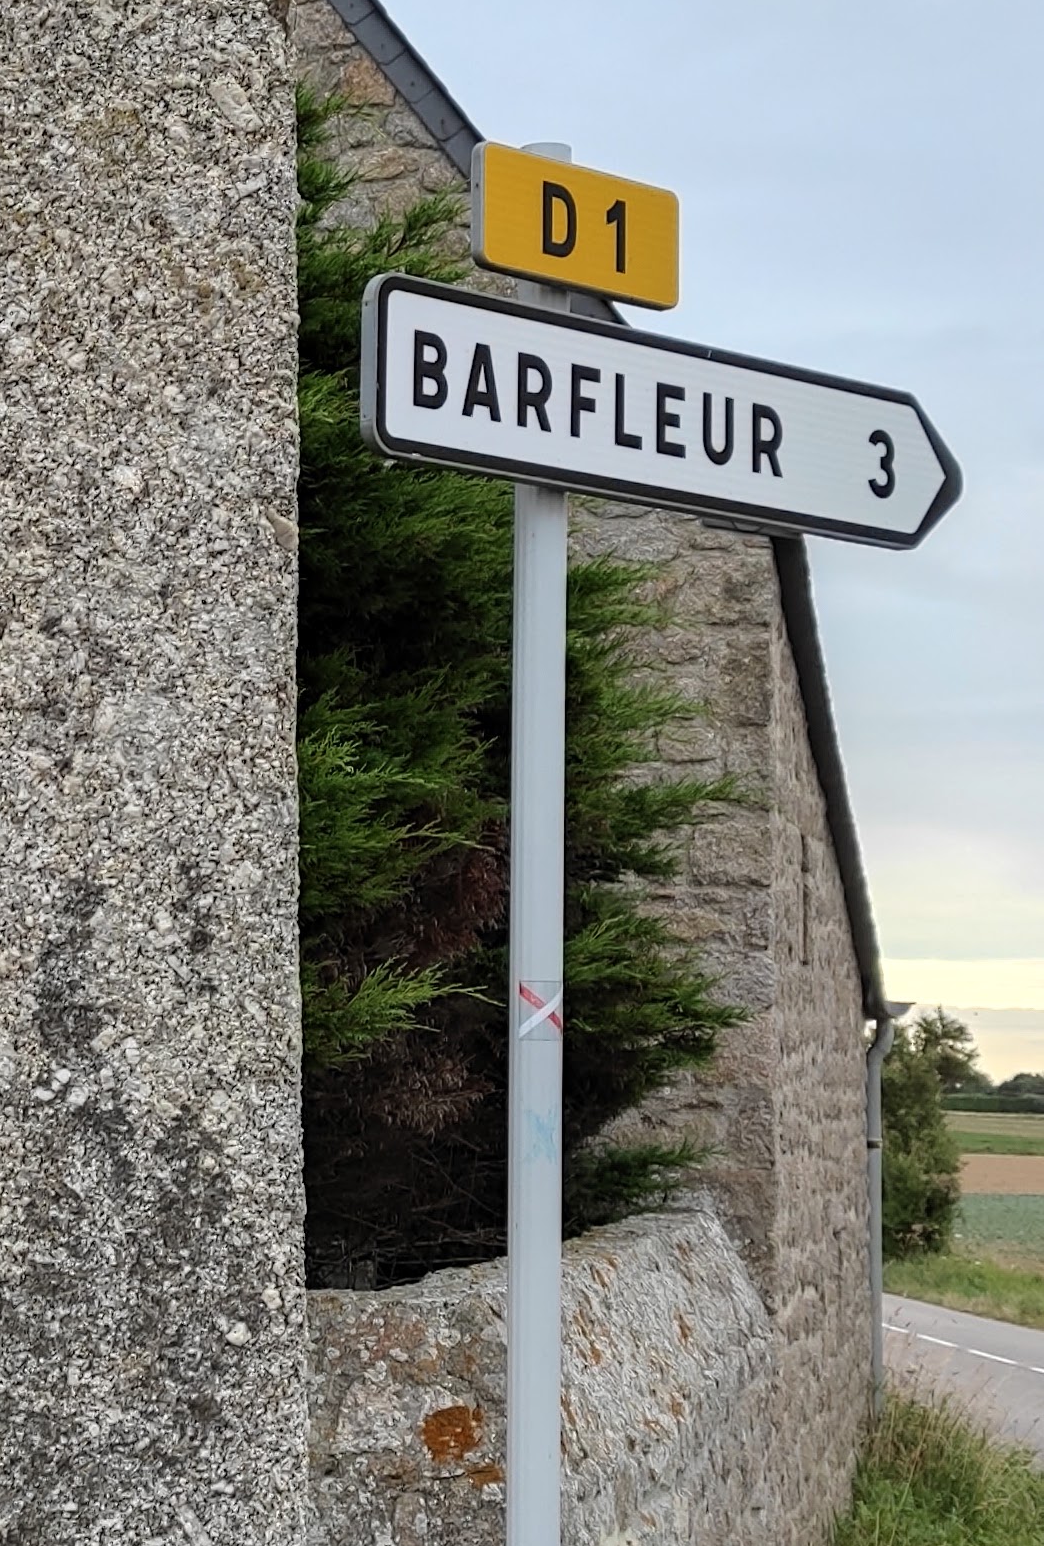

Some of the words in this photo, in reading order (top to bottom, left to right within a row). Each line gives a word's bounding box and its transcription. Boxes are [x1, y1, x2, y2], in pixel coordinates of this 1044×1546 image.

[542, 180, 577, 258] D
[605, 199, 626, 274] 1
[412, 329, 783, 478] BARFLEUR
[868, 429, 896, 500] 3
